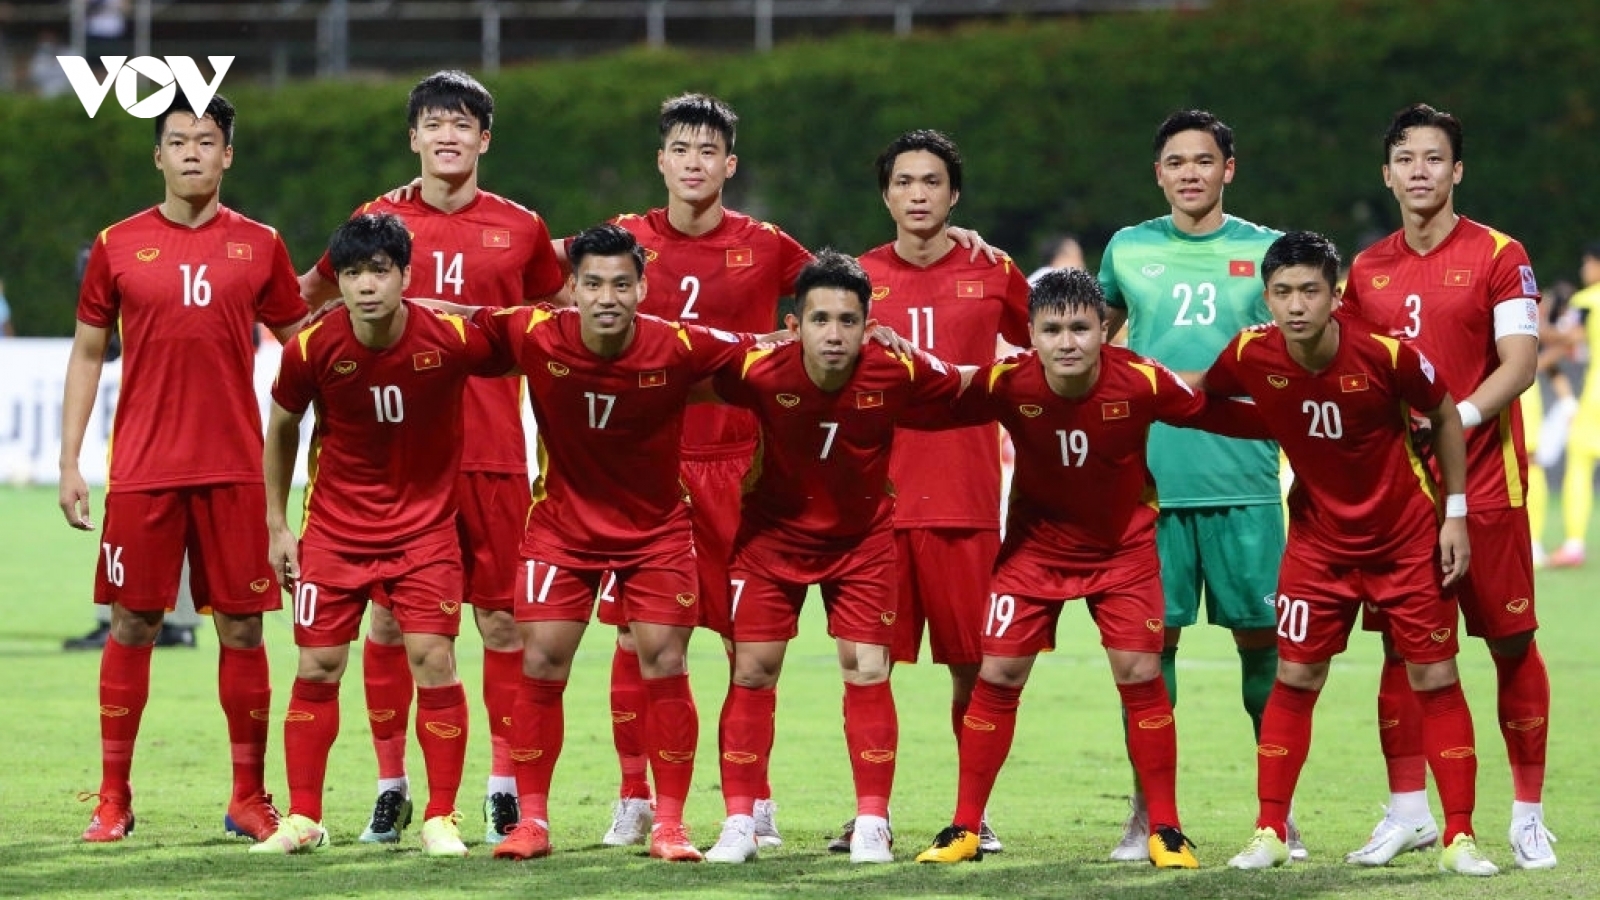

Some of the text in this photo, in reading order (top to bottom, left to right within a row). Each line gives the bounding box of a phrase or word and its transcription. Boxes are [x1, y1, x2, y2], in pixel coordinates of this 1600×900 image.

[179, 264, 211, 307] 16
[432, 251, 465, 295] 14
[680, 276, 700, 319] 2
[1172, 282, 1216, 325] 23
[1404, 294, 1421, 338] 3
[907, 307, 934, 349] 11
[370, 386, 403, 423] 10
[585, 392, 616, 429] 17
[1302, 400, 1343, 440] 20
[820, 422, 838, 460] 7
[1056, 429, 1088, 467] 19
[103, 542, 124, 587] 16
[525, 559, 557, 604] 17
[294, 581, 317, 626] 10
[600, 570, 616, 603] 2
[730, 579, 746, 621] 7
[986, 592, 1015, 638] 19
[1277, 594, 1309, 642] 20
